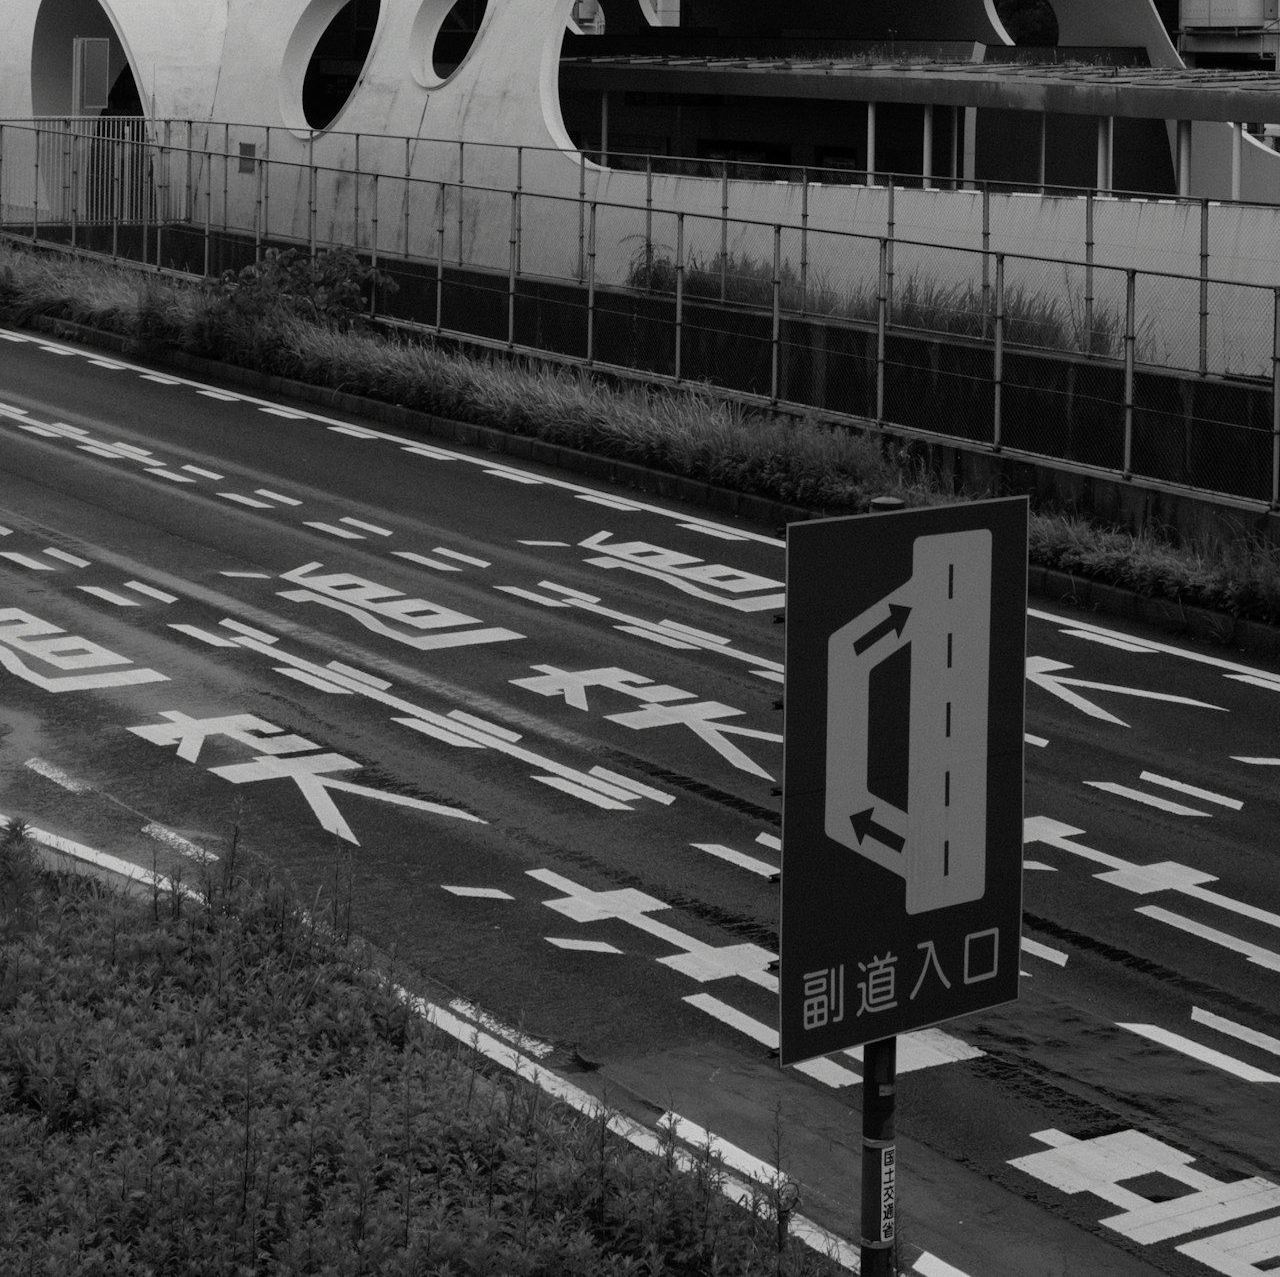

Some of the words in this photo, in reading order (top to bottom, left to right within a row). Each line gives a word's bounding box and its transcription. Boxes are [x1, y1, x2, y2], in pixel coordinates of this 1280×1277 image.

[803, 926, 999, 1031] 副道入口
[882, 1149, 895, 1239] 国土交通省
